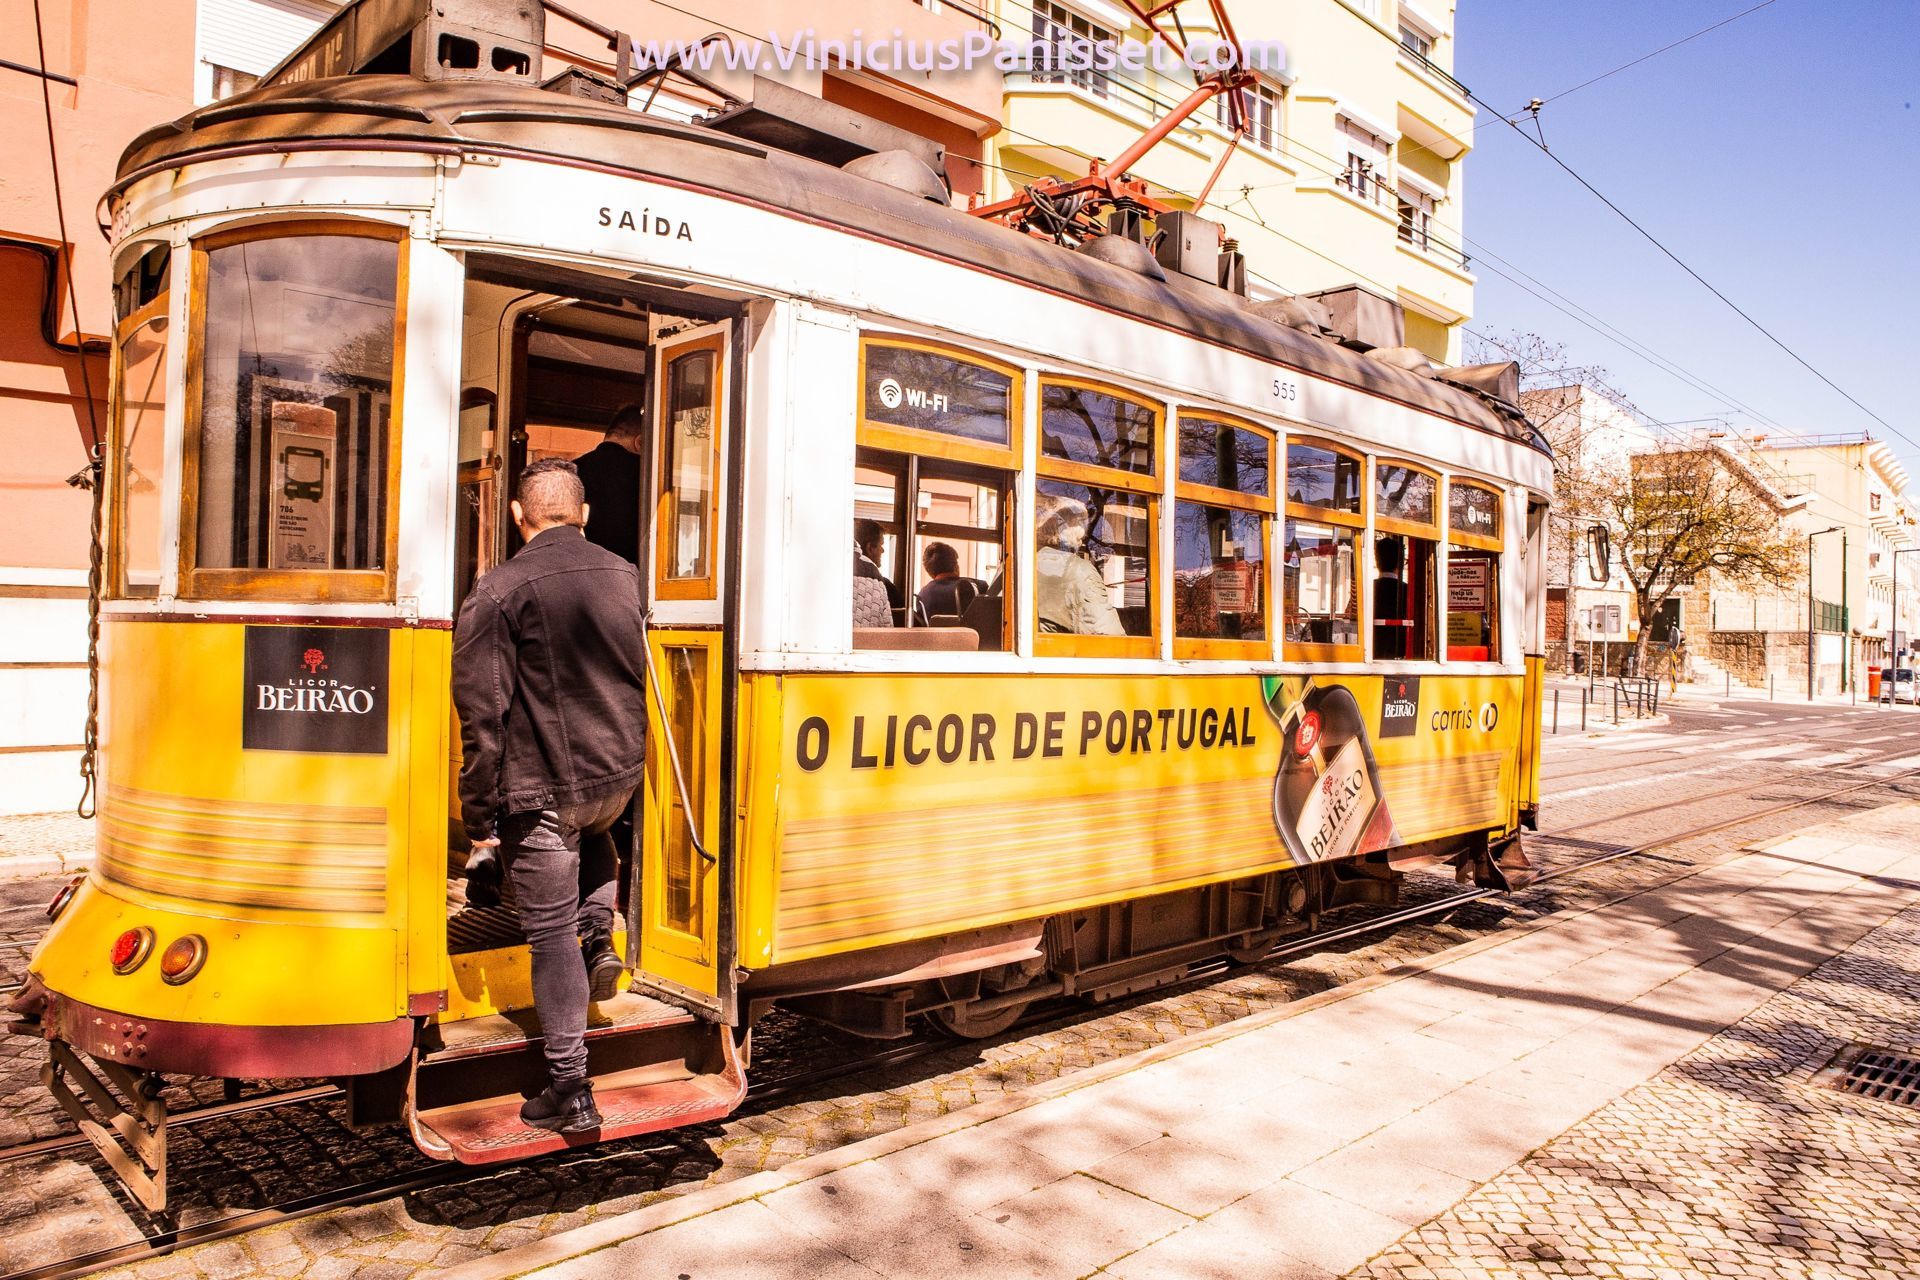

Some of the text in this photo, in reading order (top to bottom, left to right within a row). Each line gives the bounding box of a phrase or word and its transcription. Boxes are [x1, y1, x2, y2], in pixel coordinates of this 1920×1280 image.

[598, 207, 693, 242] SAÍDA
[905, 387, 948, 413] WI-FI
[1273, 379, 1296, 401] 555
[1476, 510, 1491, 525] WI-FI
[1450, 589, 1465, 597] Help
[289, 678, 338, 687] LICOR
[257, 684, 374, 714] BEIRÃO
[1431, 701, 1473, 732] carris
[797, 706, 1257, 771] O LICOR DE PORTUGAL
[1311, 769, 1363, 859] BEIRÃO
